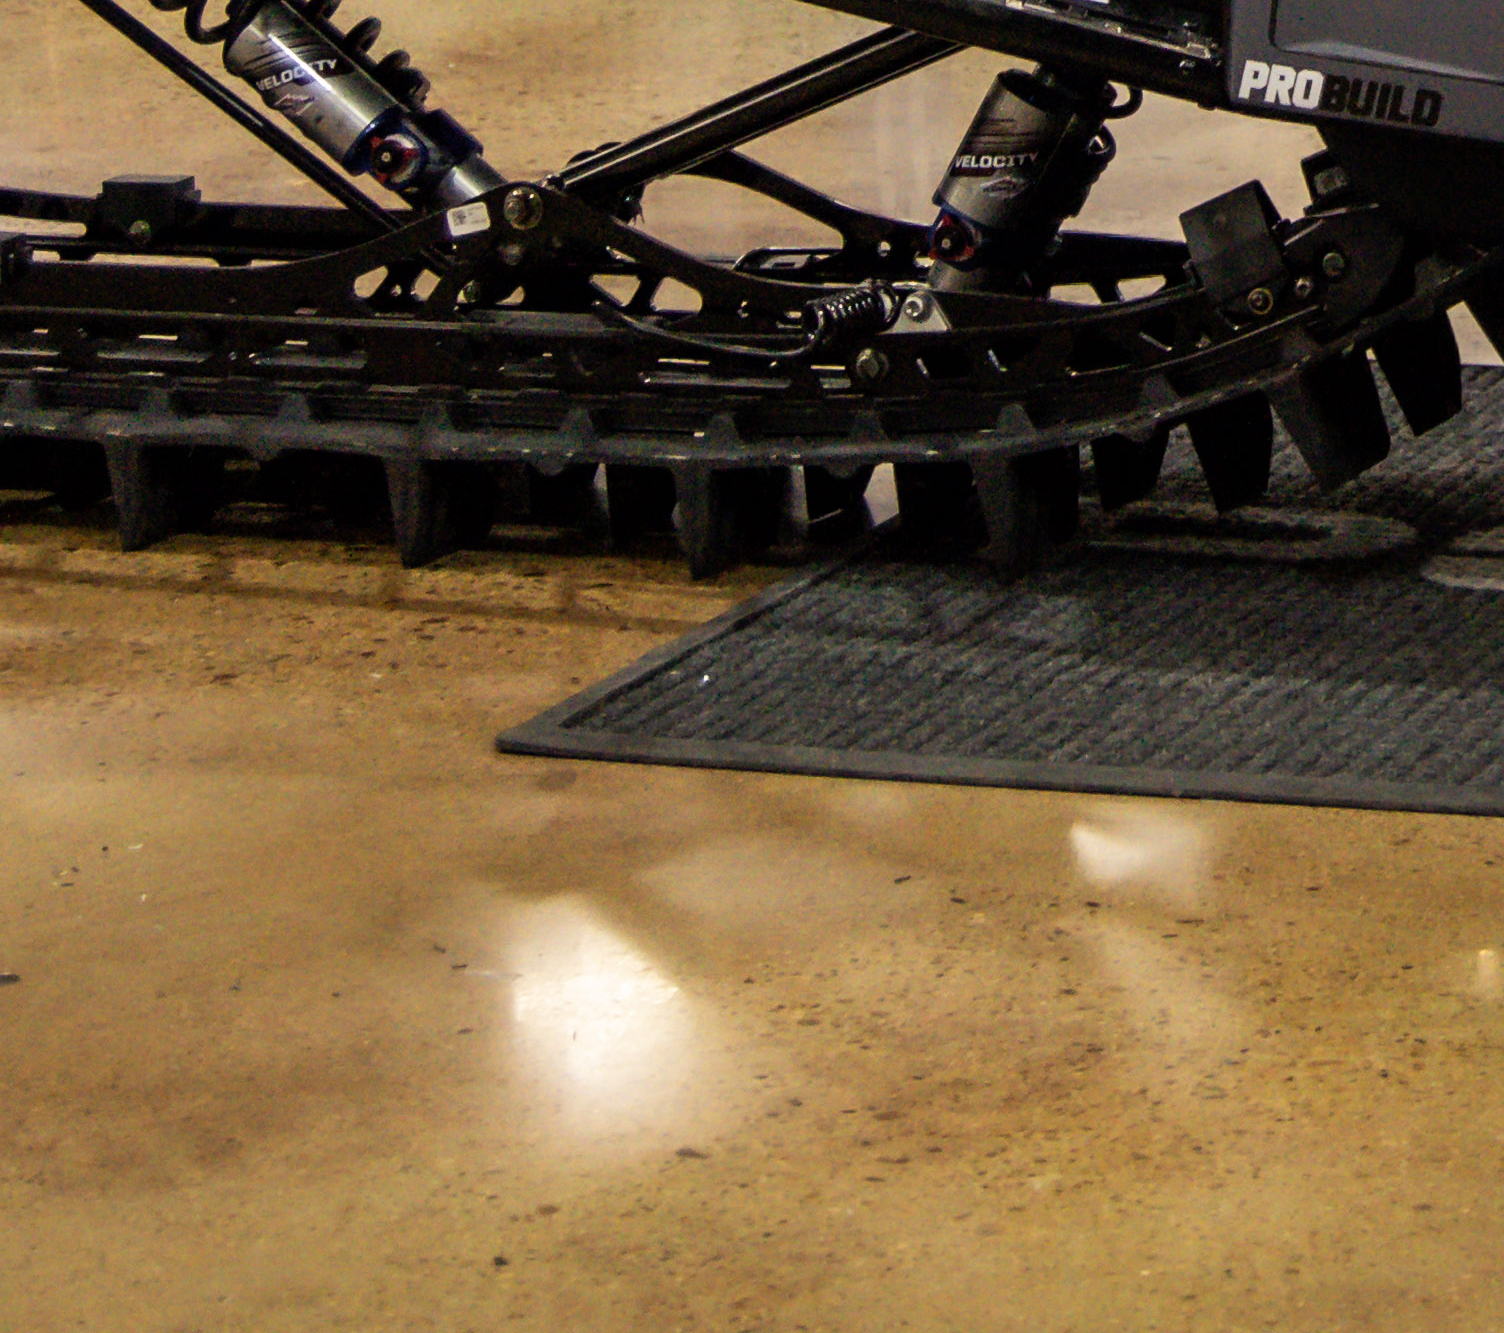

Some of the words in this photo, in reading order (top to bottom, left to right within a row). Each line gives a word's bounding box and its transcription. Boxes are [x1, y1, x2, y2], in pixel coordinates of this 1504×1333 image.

[255, 57, 338, 93] VELOCITY
[1238, 60, 1442, 127] PROBUILD
[954, 150, 1040, 169] VELOCITY
